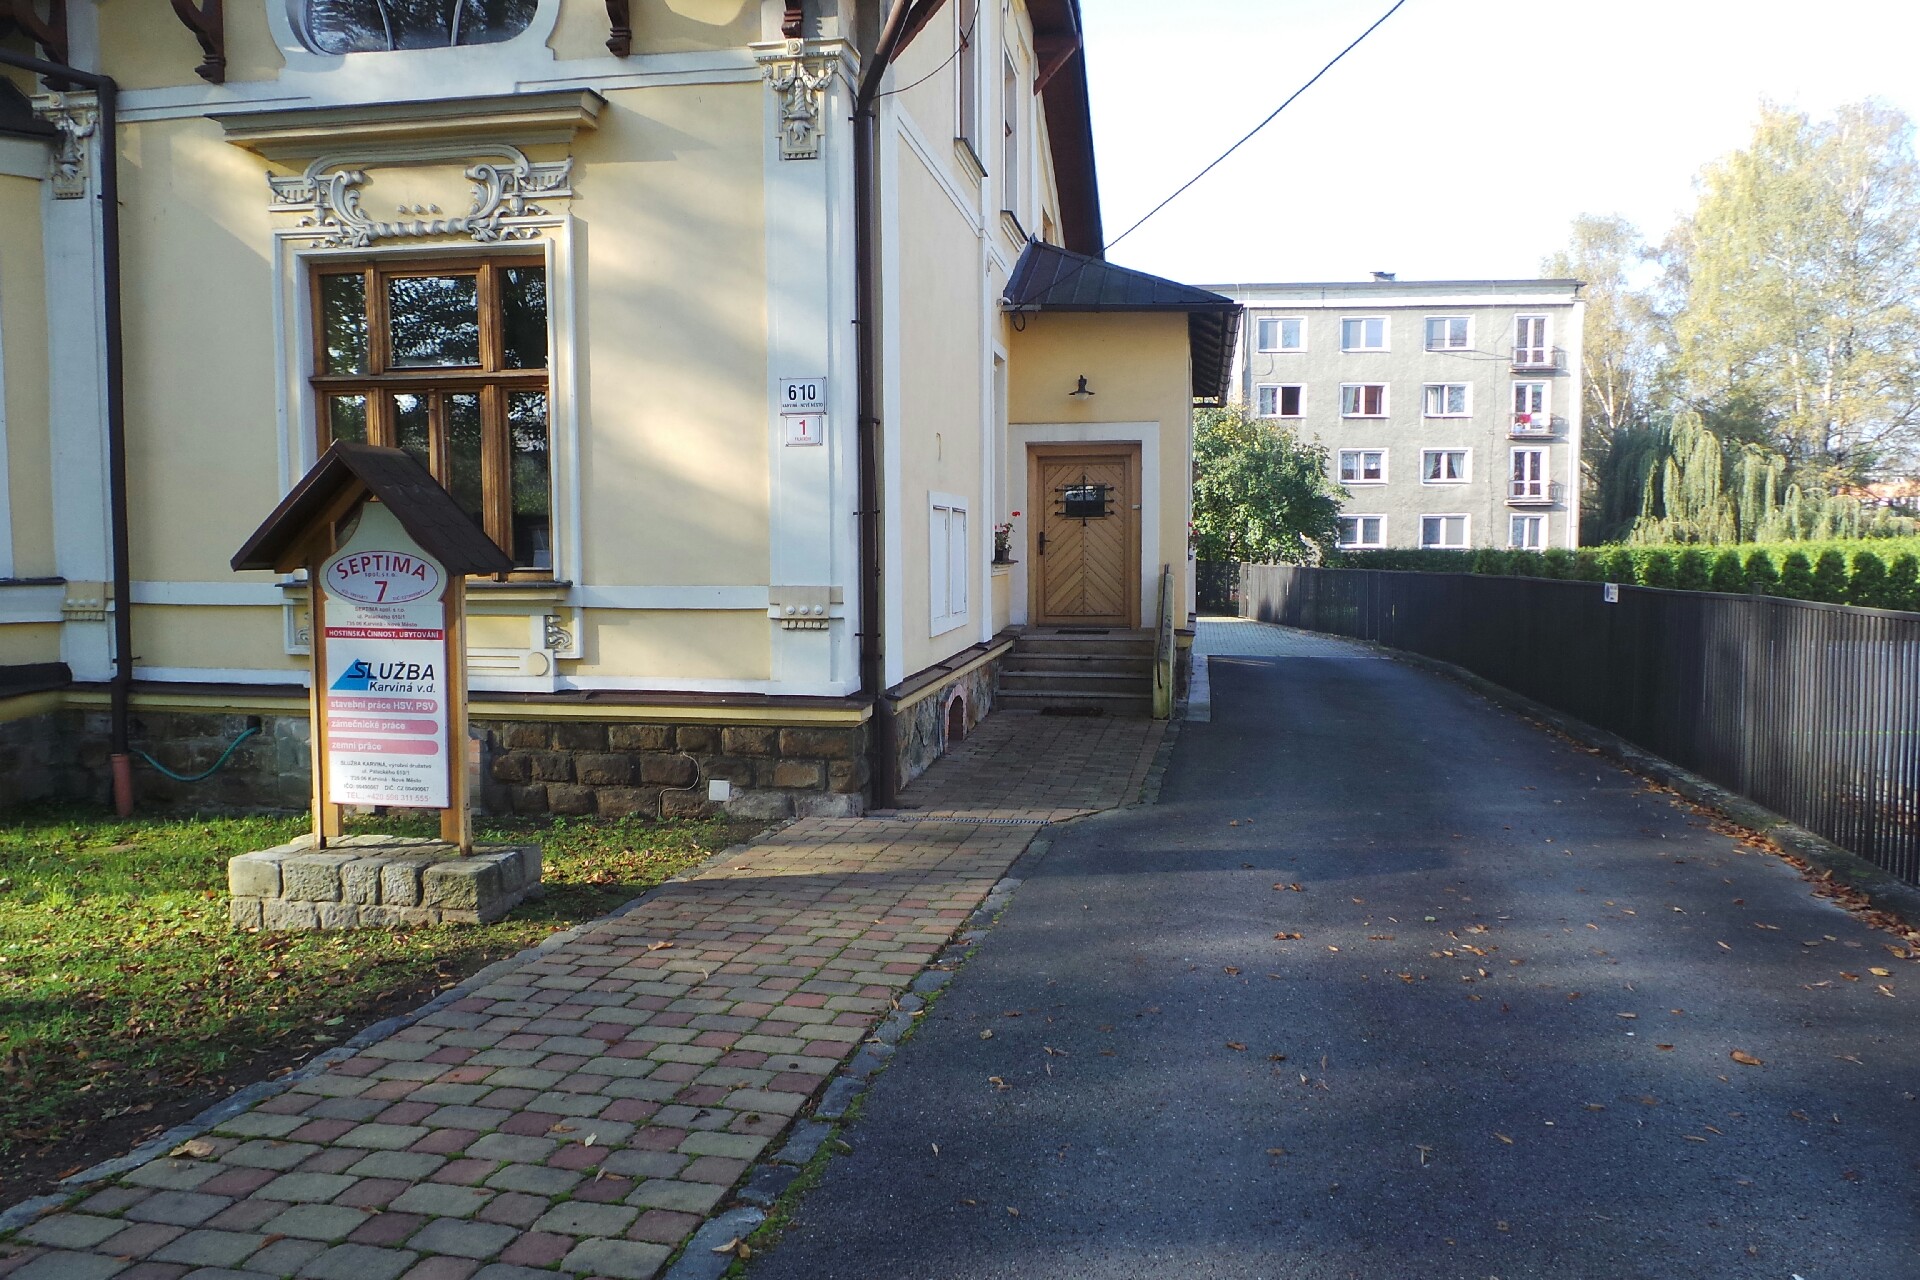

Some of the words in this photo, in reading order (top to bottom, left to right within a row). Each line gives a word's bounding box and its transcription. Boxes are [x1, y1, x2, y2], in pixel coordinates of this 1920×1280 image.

[788, 384, 816, 400] 610
[799, 420, 806, 436] 1
[336, 555, 425, 581] SEPTIMA
[375, 581, 388, 602] 7
[400, 630, 439, 638] UBYTOVÁNÍ
[346, 661, 435, 681] SLUŽBA
[370, 682, 413, 692] Karviná
[416, 683, 436, 693] v.d.
[331, 700, 366, 708] stavební
[368, 701, 391, 710] práce
[416, 703, 434, 711] PSV
[331, 718, 380, 728] zámečnické
[382, 720, 406, 730] práce
[332, 741, 356, 749] zemní
[358, 742, 382, 751] práce
